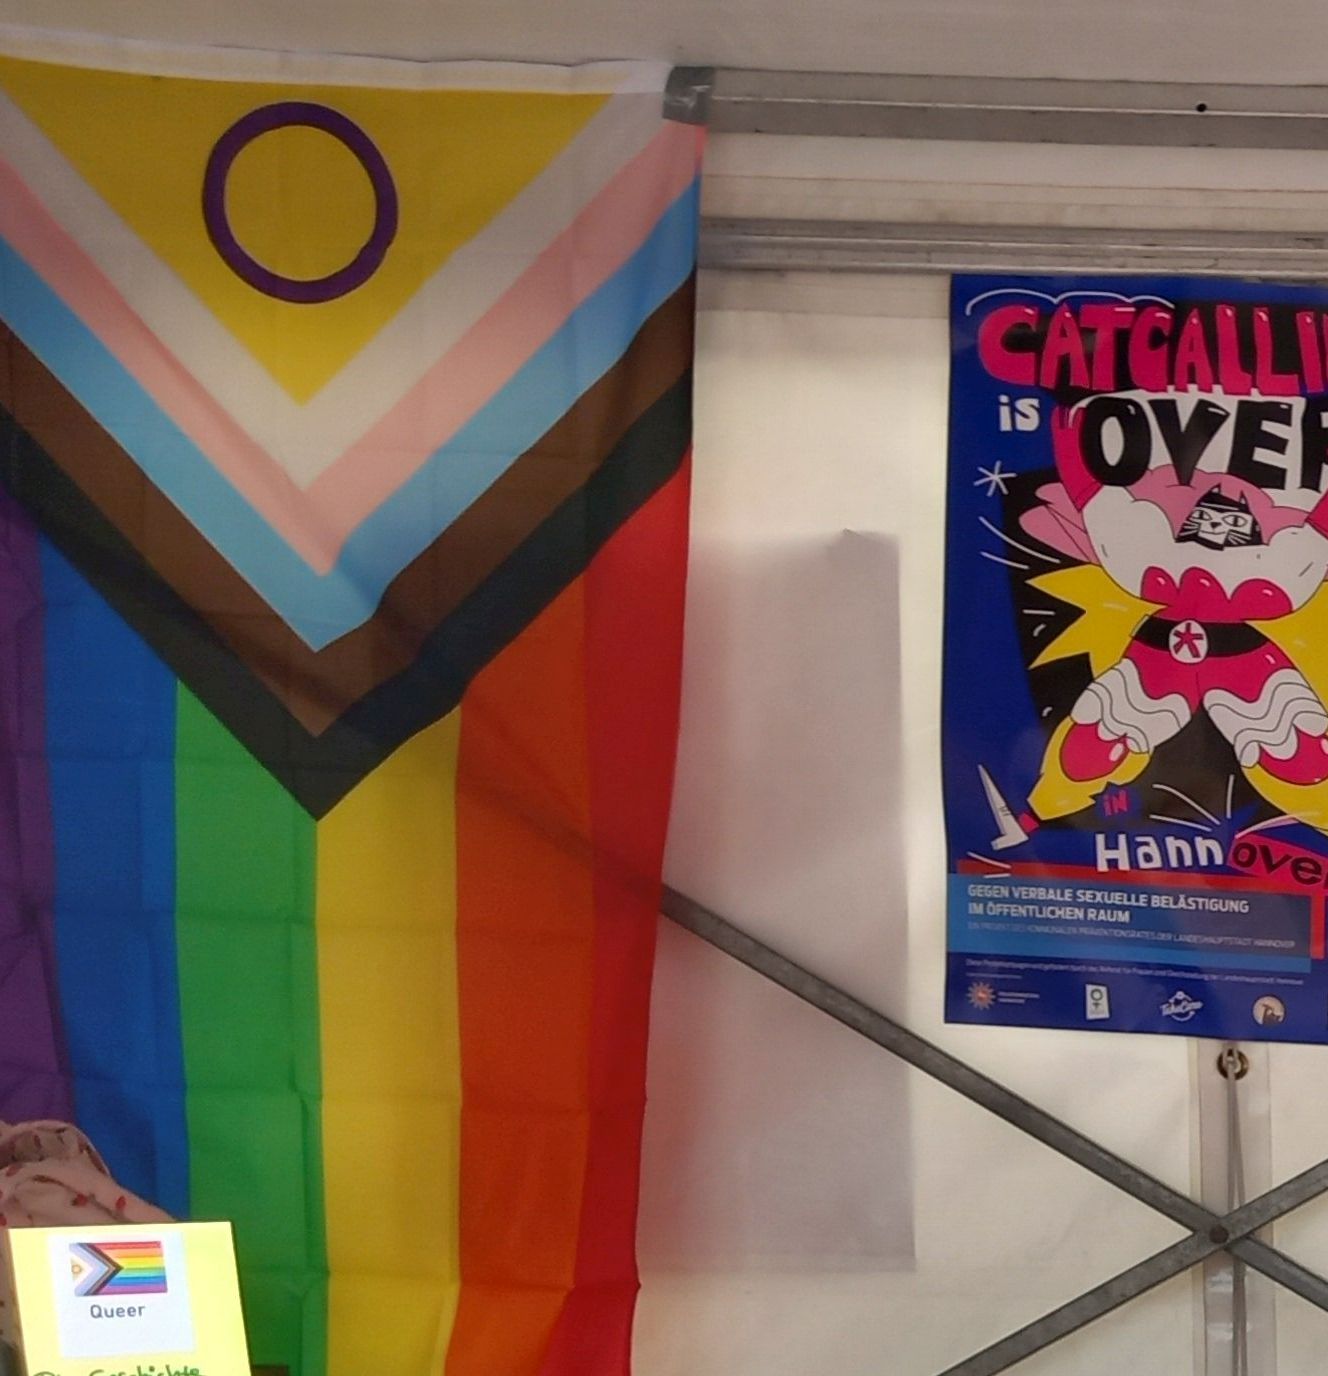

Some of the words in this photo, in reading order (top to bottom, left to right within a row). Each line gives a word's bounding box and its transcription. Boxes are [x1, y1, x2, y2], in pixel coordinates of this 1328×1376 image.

[1000, 395, 1040, 432] is
[1103, 791, 1129, 815] IN
[968, 884, 1009, 900] GEGEN
[1012, 886, 1074, 902] VERBALE
[1076, 889, 1148, 907] SEXUELLE
[1151, 893, 1249, 913] BELÄSTIGUNG
[968, 903, 984, 915] IM
[987, 901, 1083, 920] ÖFFENTLICHEN
[1088, 908, 1130, 923] RAUM
[90, 1304, 146, 1319] Queer
